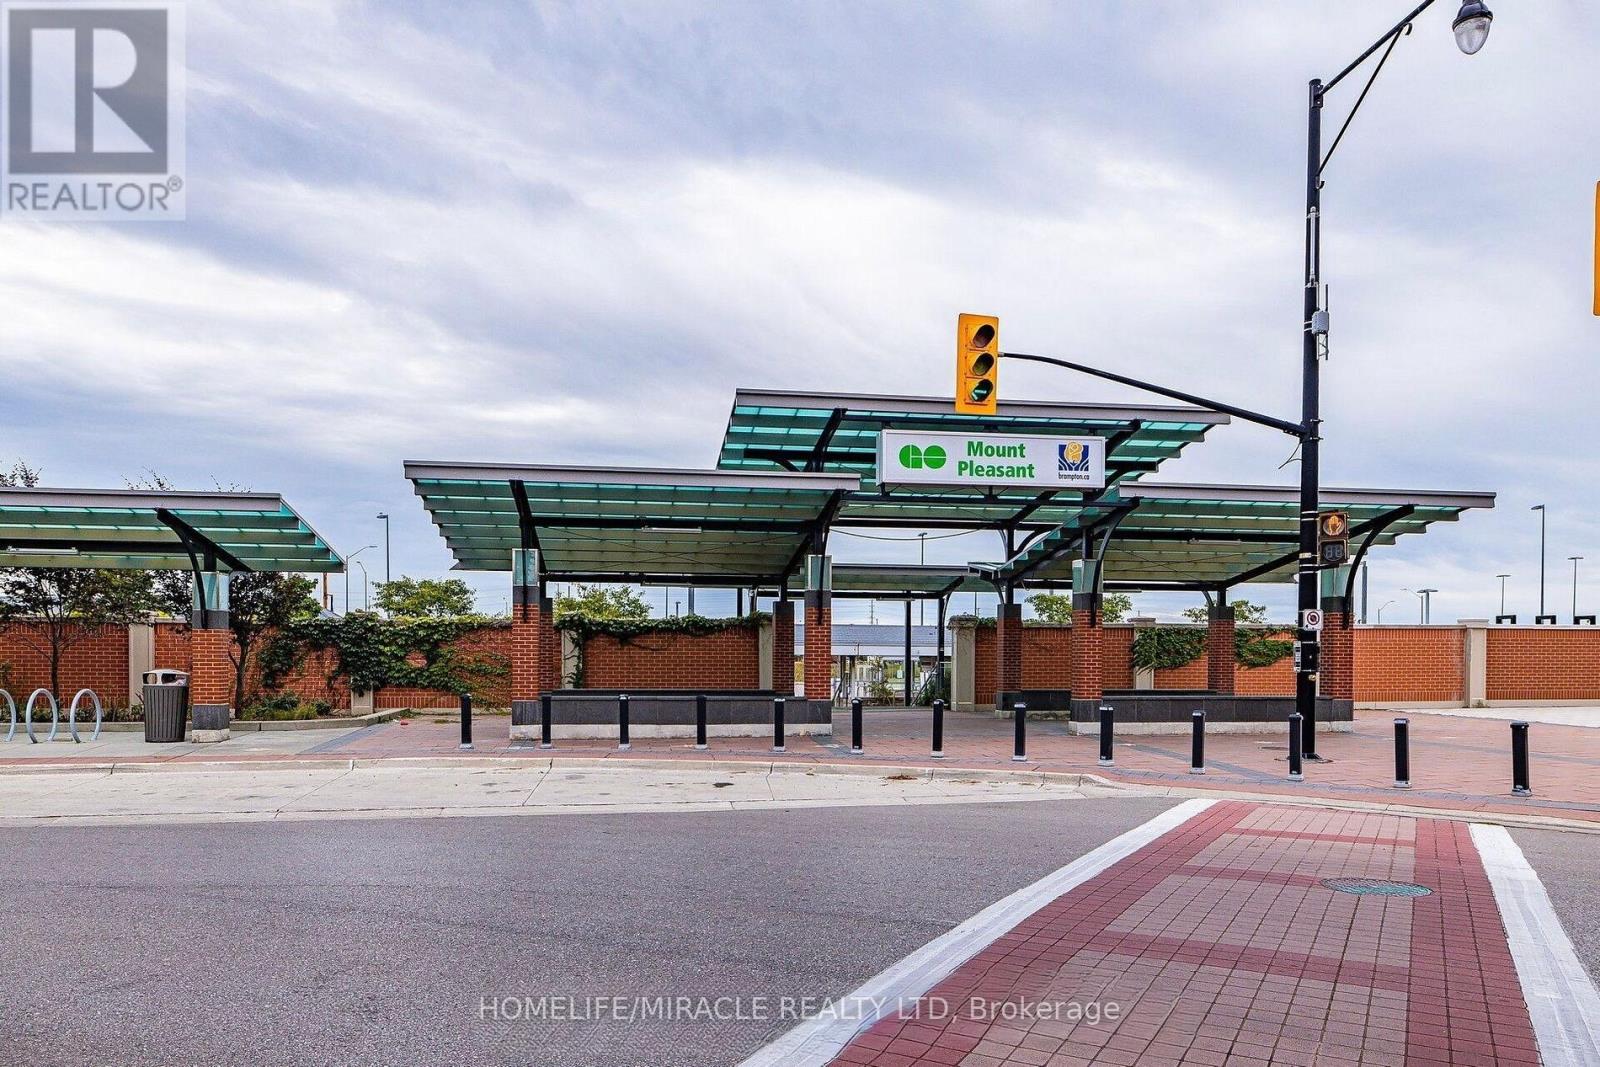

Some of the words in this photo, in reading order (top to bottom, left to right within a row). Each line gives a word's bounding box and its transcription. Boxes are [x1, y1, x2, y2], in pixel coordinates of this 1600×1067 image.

[899, 444, 947, 469] GO
[966, 441, 1026, 459] Mount
[957, 460, 1035, 479] Pleasant
[1058, 472, 1090, 481] brampton.ca
